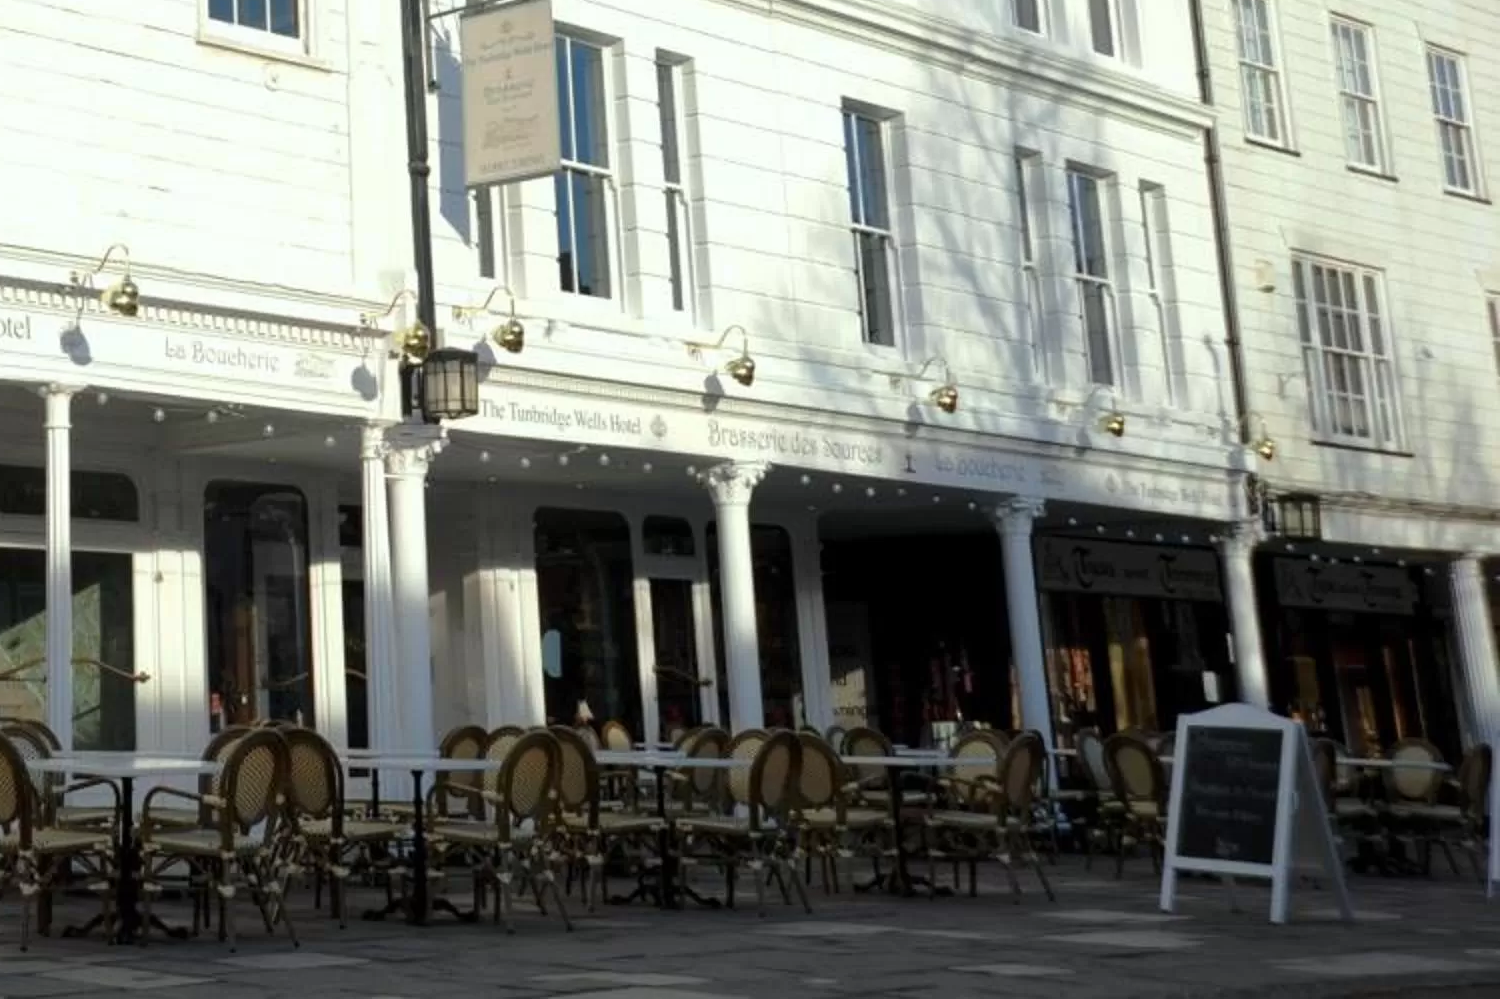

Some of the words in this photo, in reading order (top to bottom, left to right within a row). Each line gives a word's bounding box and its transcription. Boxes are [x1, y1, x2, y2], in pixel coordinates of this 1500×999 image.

[165, 336, 186, 359] La
[192, 341, 280, 373] Boucherie
[480, 399, 506, 419] The
[508, 402, 572, 432] Tunbridge
[574, 409, 607, 431] Wells
[610, 414, 642, 435] Hotel
[708, 420, 787, 453] Brasserie
[791, 431, 817, 457] des
[823, 438, 883, 465] Sources
